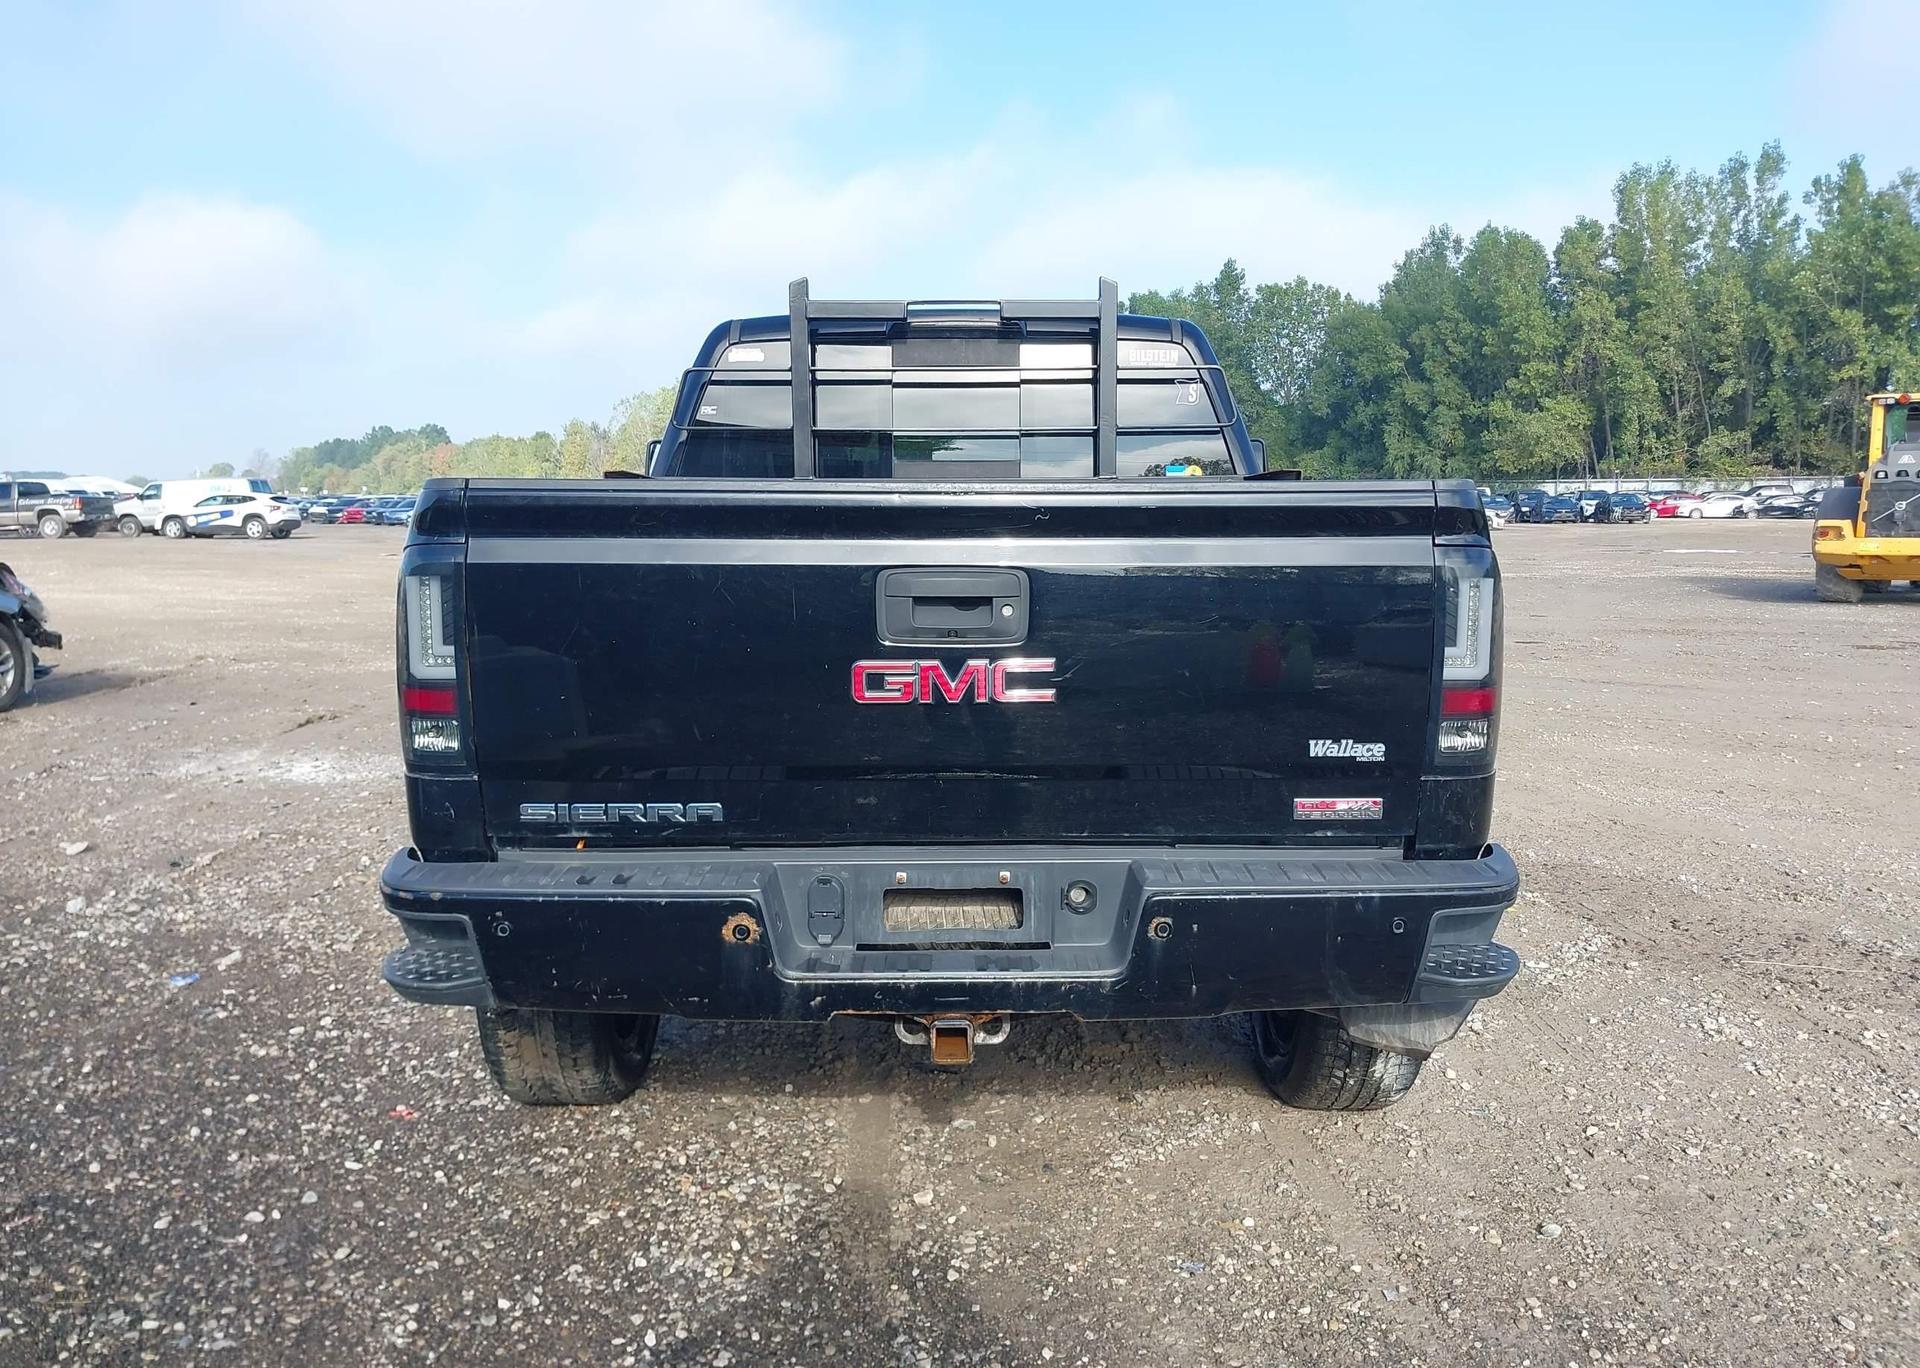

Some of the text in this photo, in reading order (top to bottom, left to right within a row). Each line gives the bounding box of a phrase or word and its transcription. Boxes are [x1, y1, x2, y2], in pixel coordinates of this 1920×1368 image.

[1129, 349, 1179, 361] BILSTEIN
[851, 657, 1056, 704] GMC
[1308, 739, 1386, 757] Wallace
[519, 802, 723, 822] SIERRA
